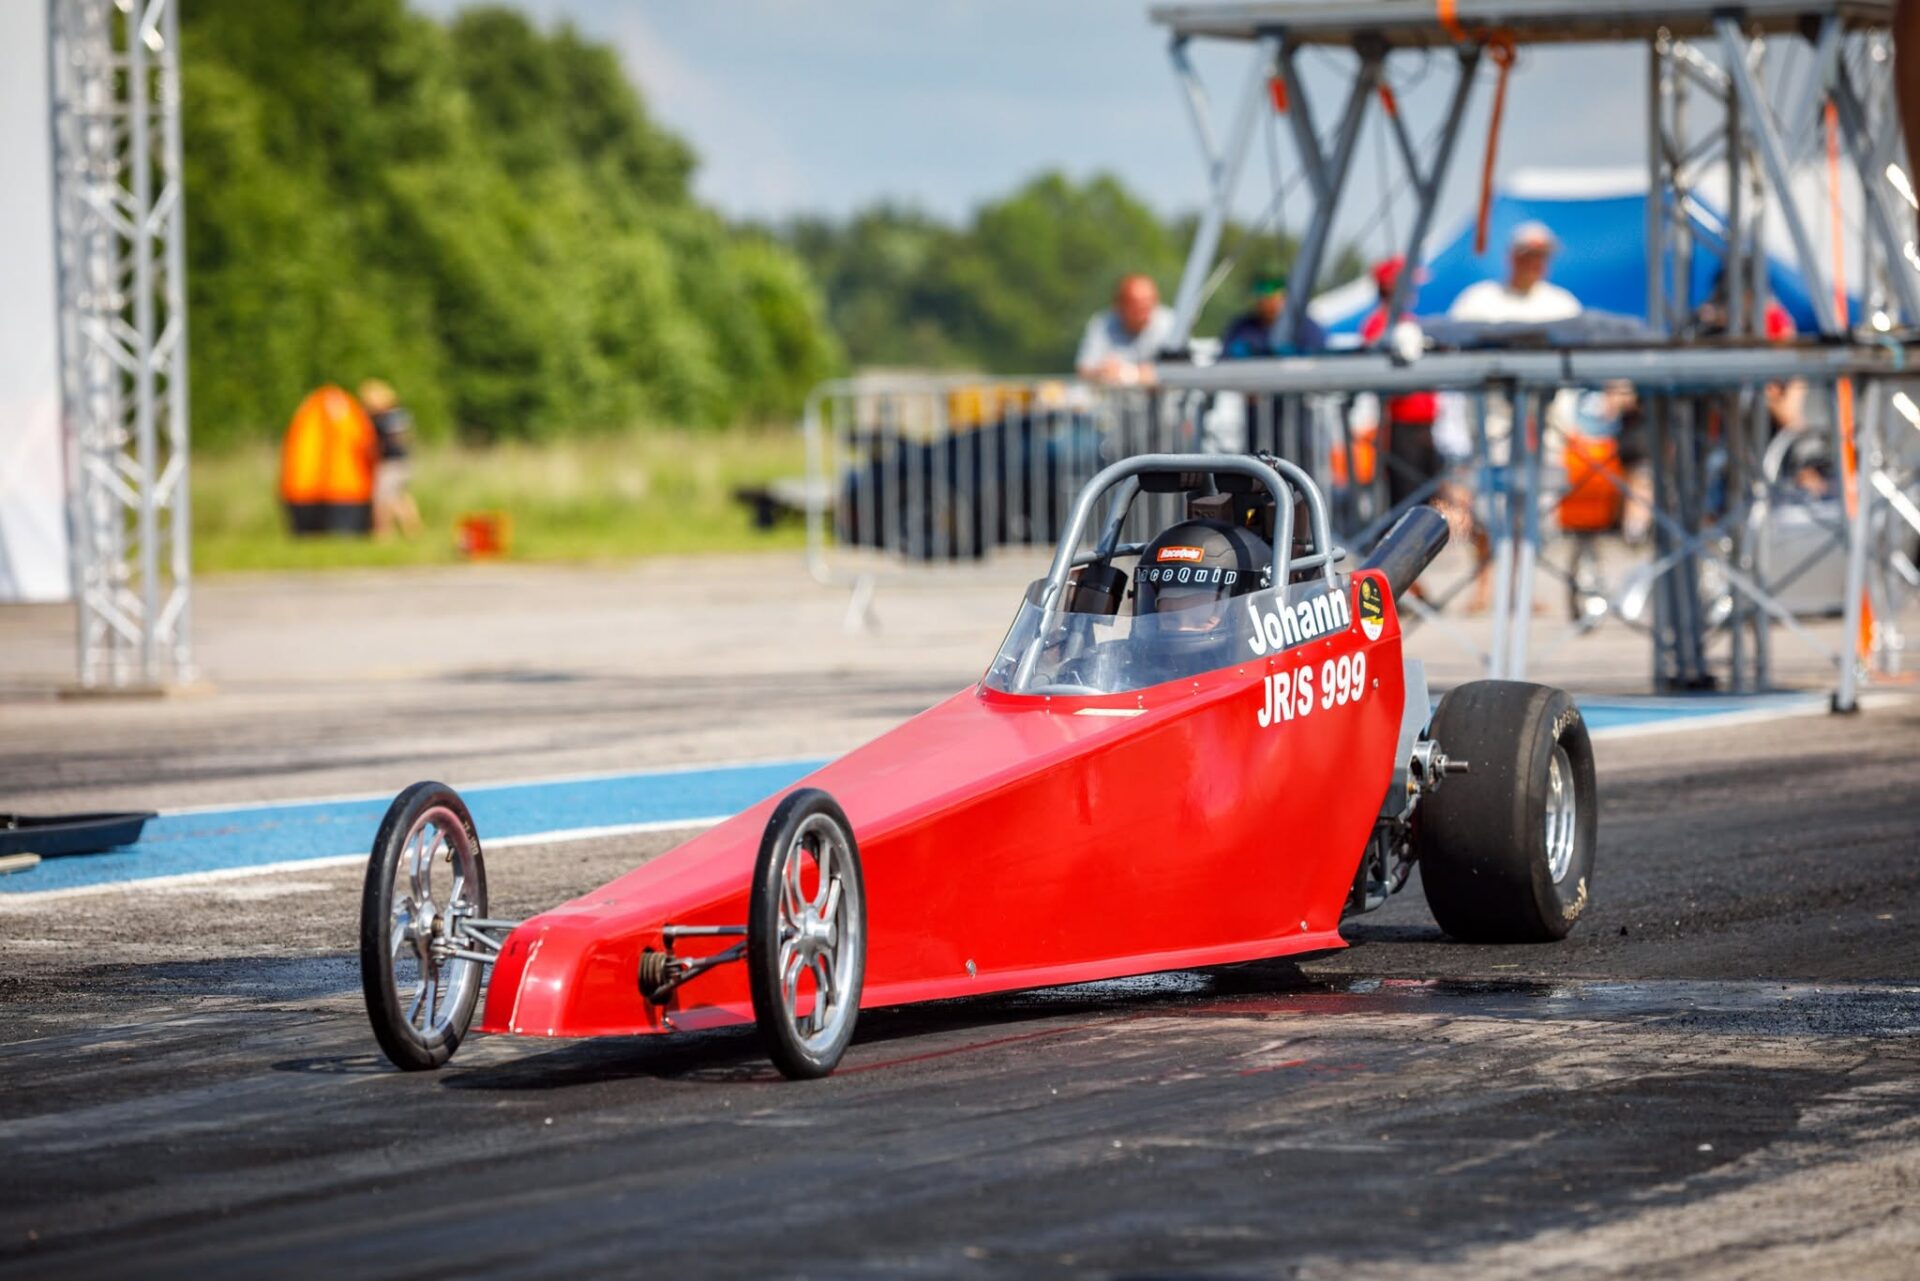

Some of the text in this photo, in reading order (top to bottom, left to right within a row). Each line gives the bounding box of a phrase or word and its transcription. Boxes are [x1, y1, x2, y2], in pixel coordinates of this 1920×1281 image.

[1248, 589, 1349, 655] Johann
[1257, 651, 1366, 728] JR/S 999
